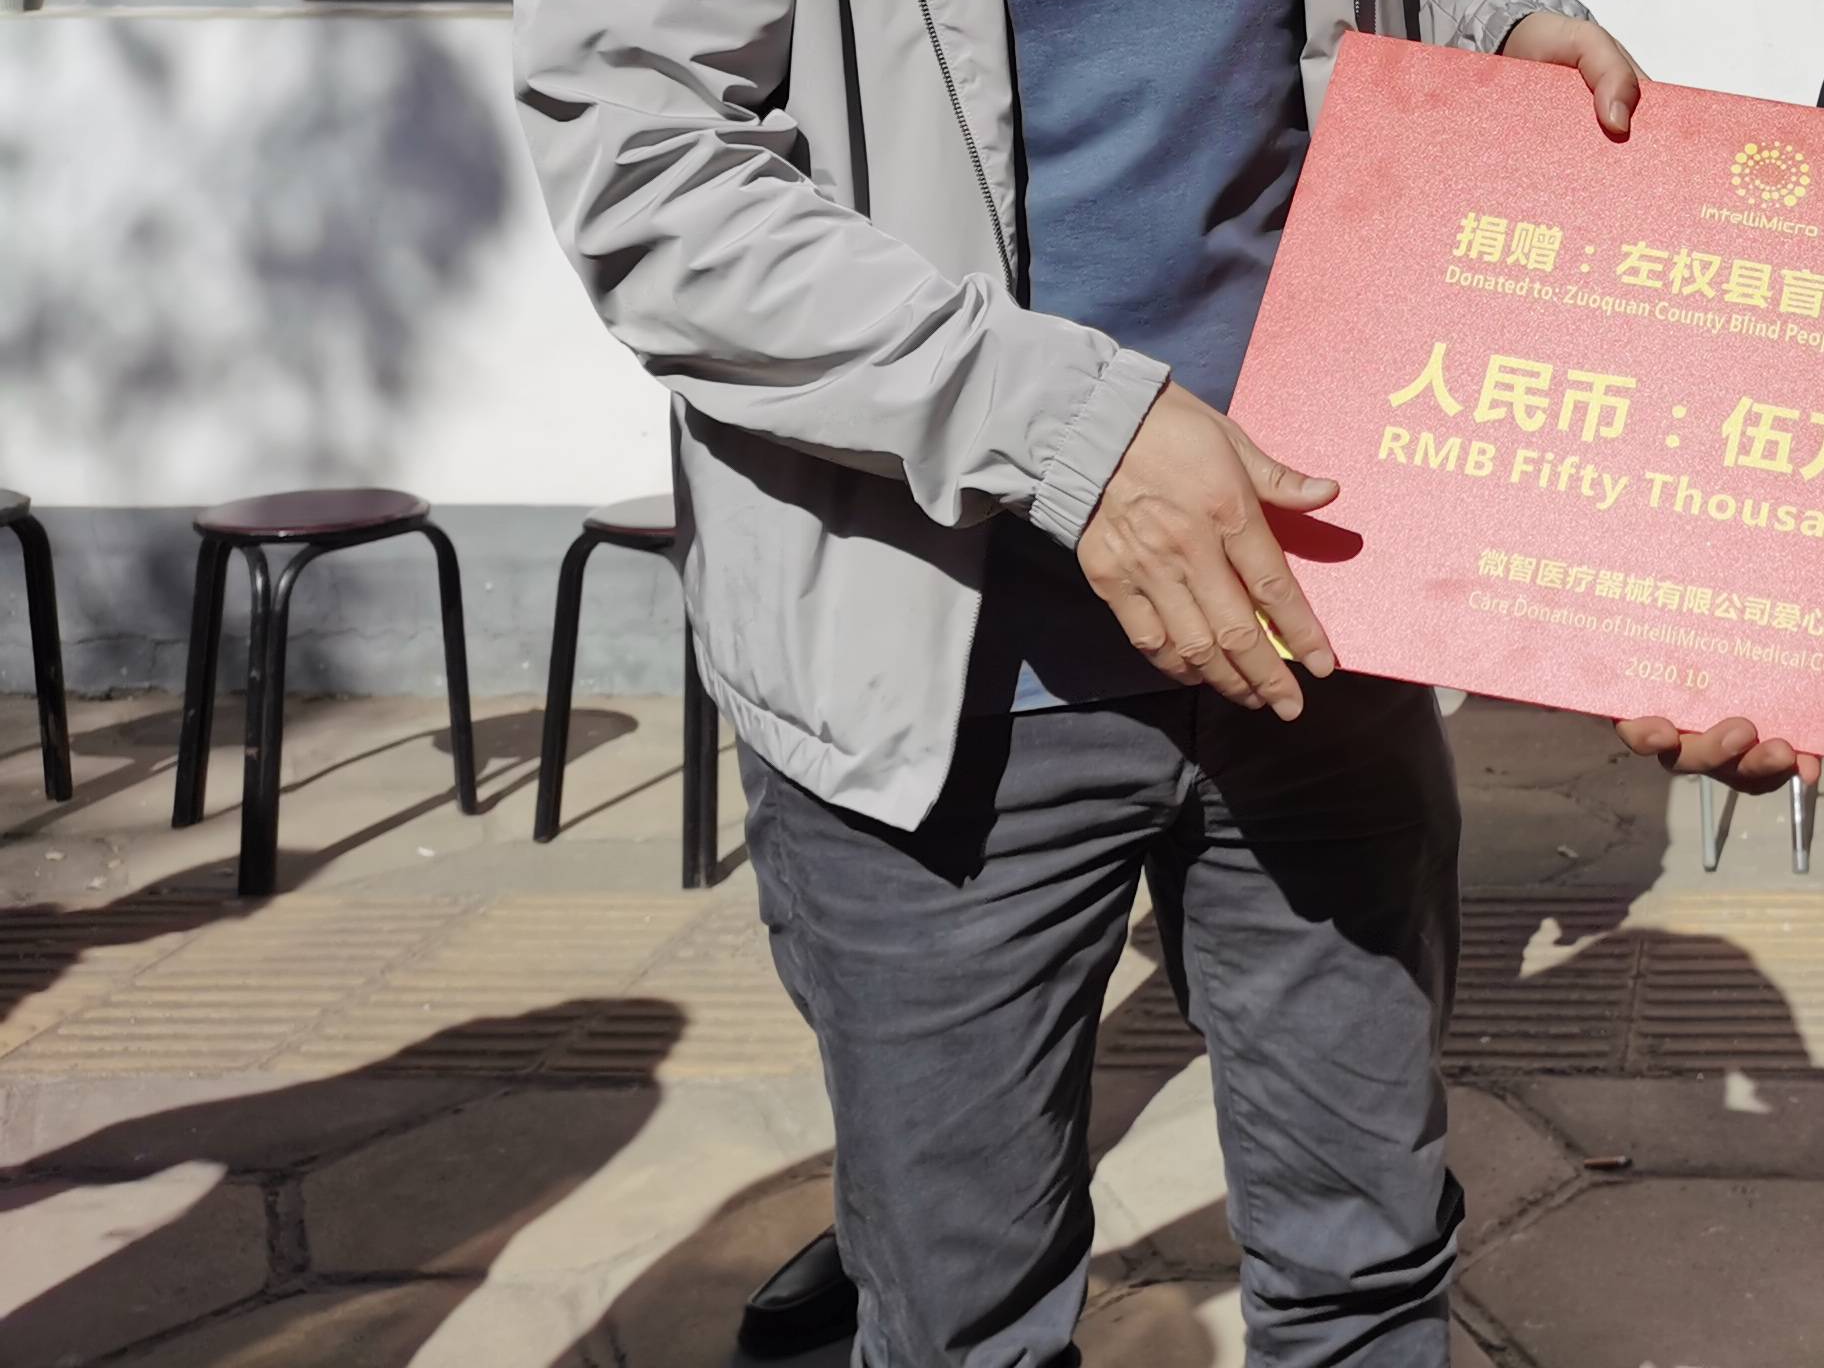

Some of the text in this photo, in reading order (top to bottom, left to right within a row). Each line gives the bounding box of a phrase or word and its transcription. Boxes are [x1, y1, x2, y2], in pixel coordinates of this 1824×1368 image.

[1700, 203, 1819, 238] IntelliMicro
[1445, 265, 1529, 297] Donated
[1532, 282, 1560, 300] to:
[1563, 285, 1650, 317] Zuoquan
[1655, 300, 1725, 335] County
[1730, 313, 1781, 341] Blind
[1378, 425, 1497, 477] RMB
[1509, 448, 1629, 510] Fifty
[1513, 597, 1597, 630] Donation
[1602, 615, 1622, 633] of
[1624, 617, 1729, 654] IntelliMicro
[1734, 638, 1806, 668] Medical
[1624, 657, 1710, 690] 2020.10
